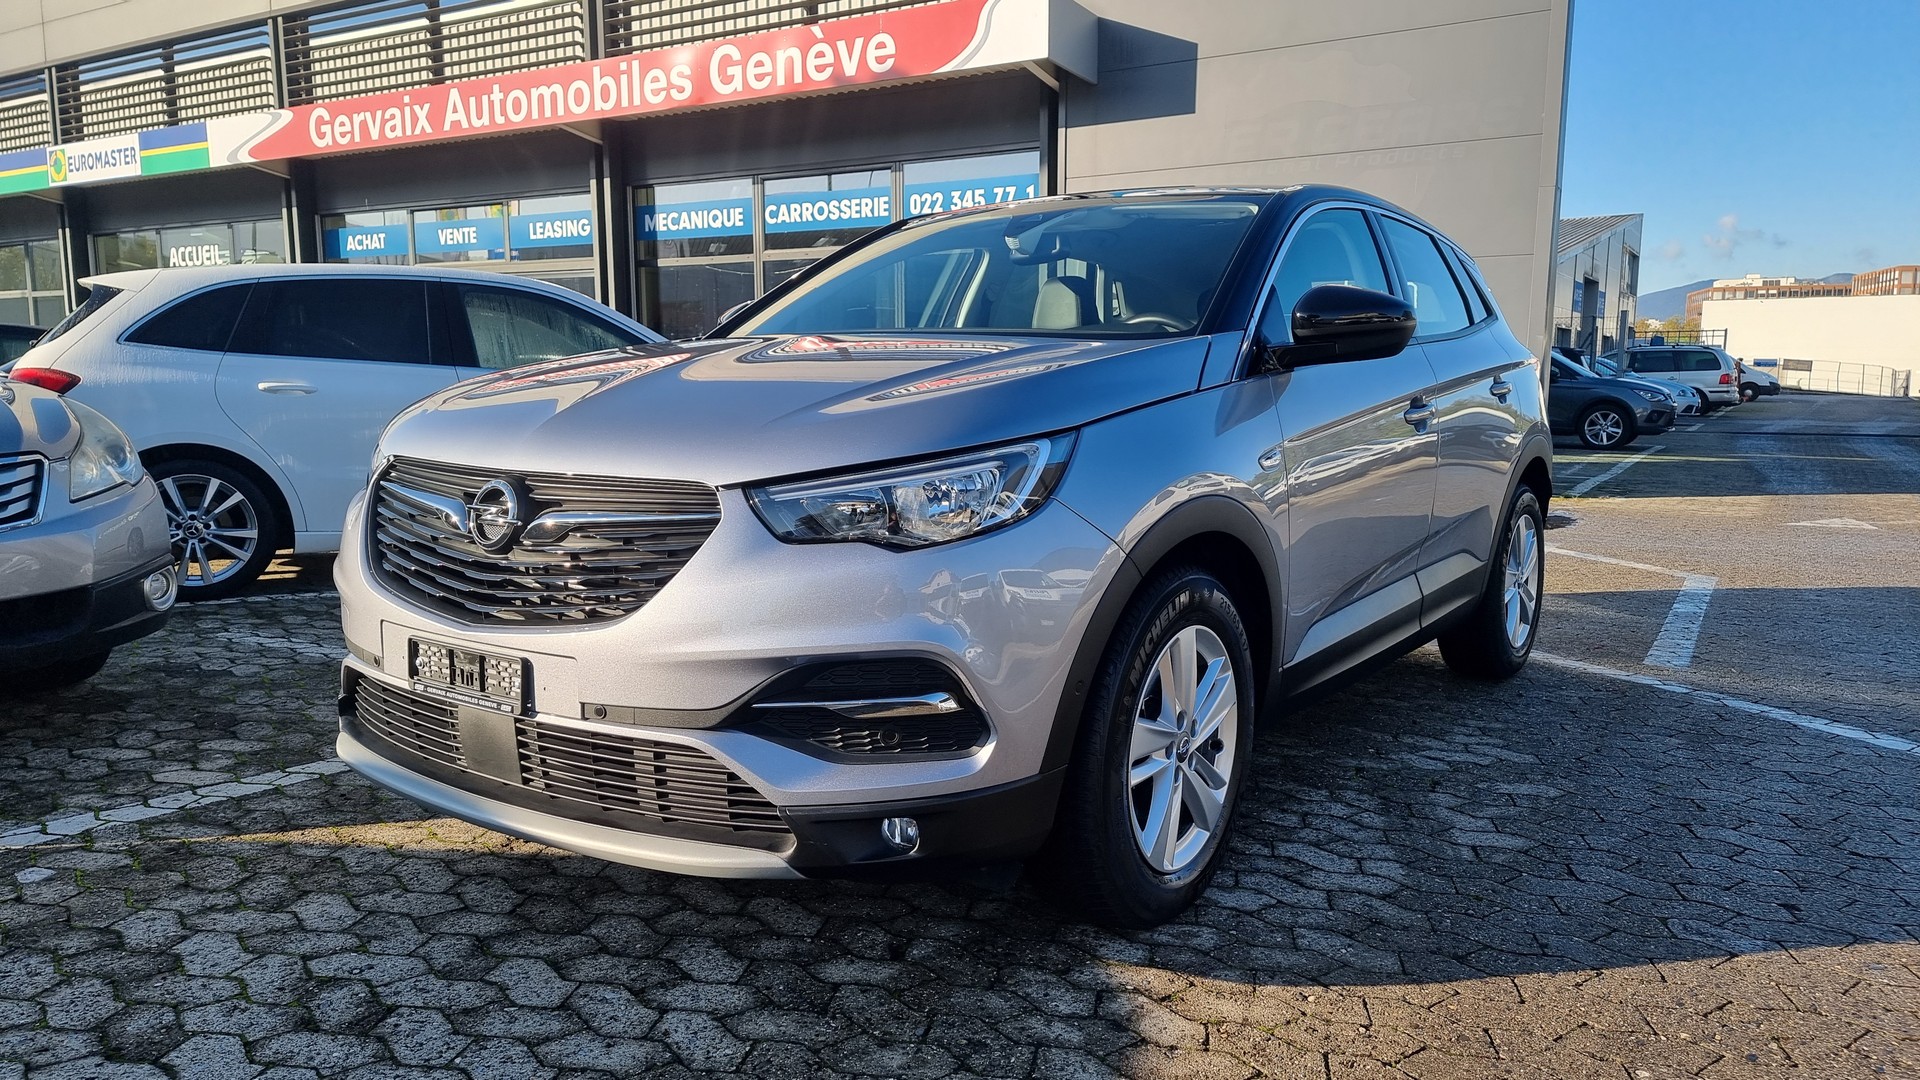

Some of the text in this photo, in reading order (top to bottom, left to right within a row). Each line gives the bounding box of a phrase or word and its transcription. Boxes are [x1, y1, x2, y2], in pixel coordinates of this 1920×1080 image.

[309, 26, 896, 148] Gervaix Automobiles Genève
[67, 146, 137, 173] EUROMASTER
[765, 196, 889, 225] CARROSSERIE
[910, 191, 944, 215] 022
[950, 188, 986, 211] 345
[529, 218, 591, 240] LEASING
[644, 207, 744, 232] MECANIQUE
[346, 233, 386, 251] ACHAT
[438, 226, 478, 246] VENTE
[169, 244, 223, 267] ACCUEIL
[1129, 589, 1191, 689] MICHELIN
[446, 692, 479, 704] AUTOMOBILES
